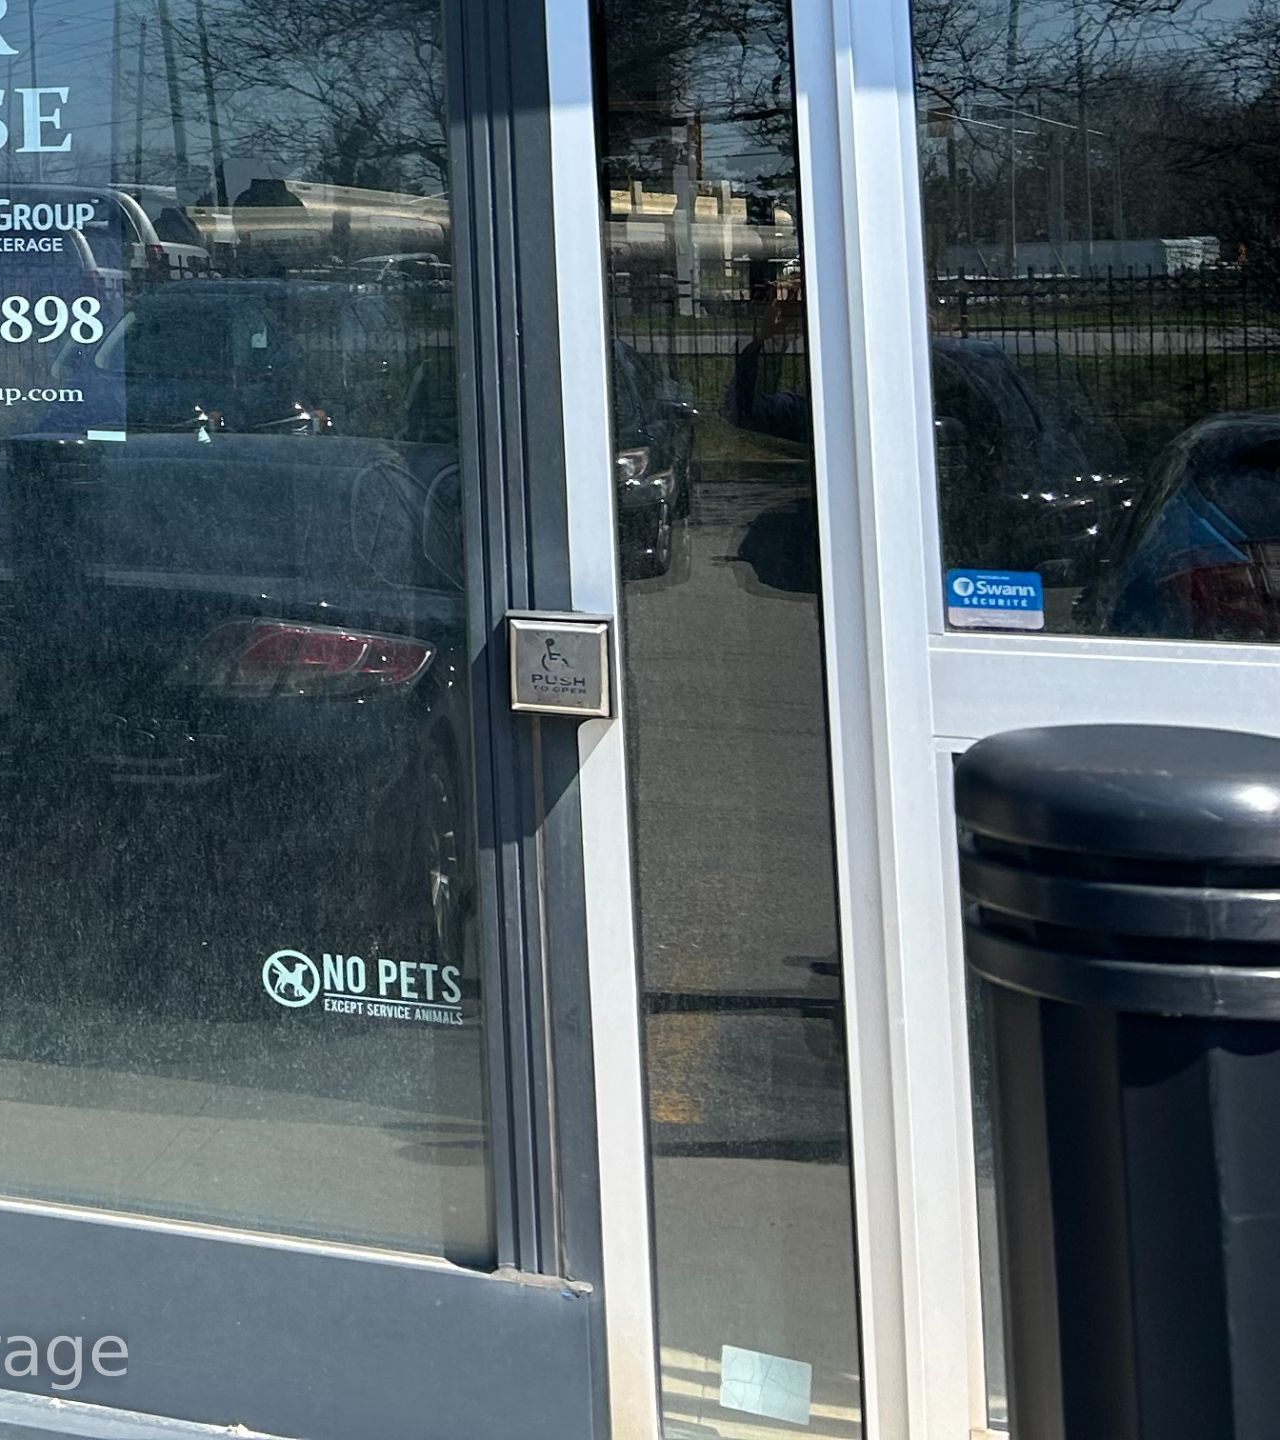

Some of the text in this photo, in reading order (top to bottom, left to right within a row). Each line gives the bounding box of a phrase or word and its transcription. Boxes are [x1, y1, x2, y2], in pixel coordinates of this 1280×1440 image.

[976, 580, 1037, 597] Swann
[531, 674, 585, 687] PUSH
[551, 686, 587, 695] OPEN
[323, 953, 462, 1004] NO PETS
[324, 998, 465, 1026] EXCEPT SERVICE ANIMALS
